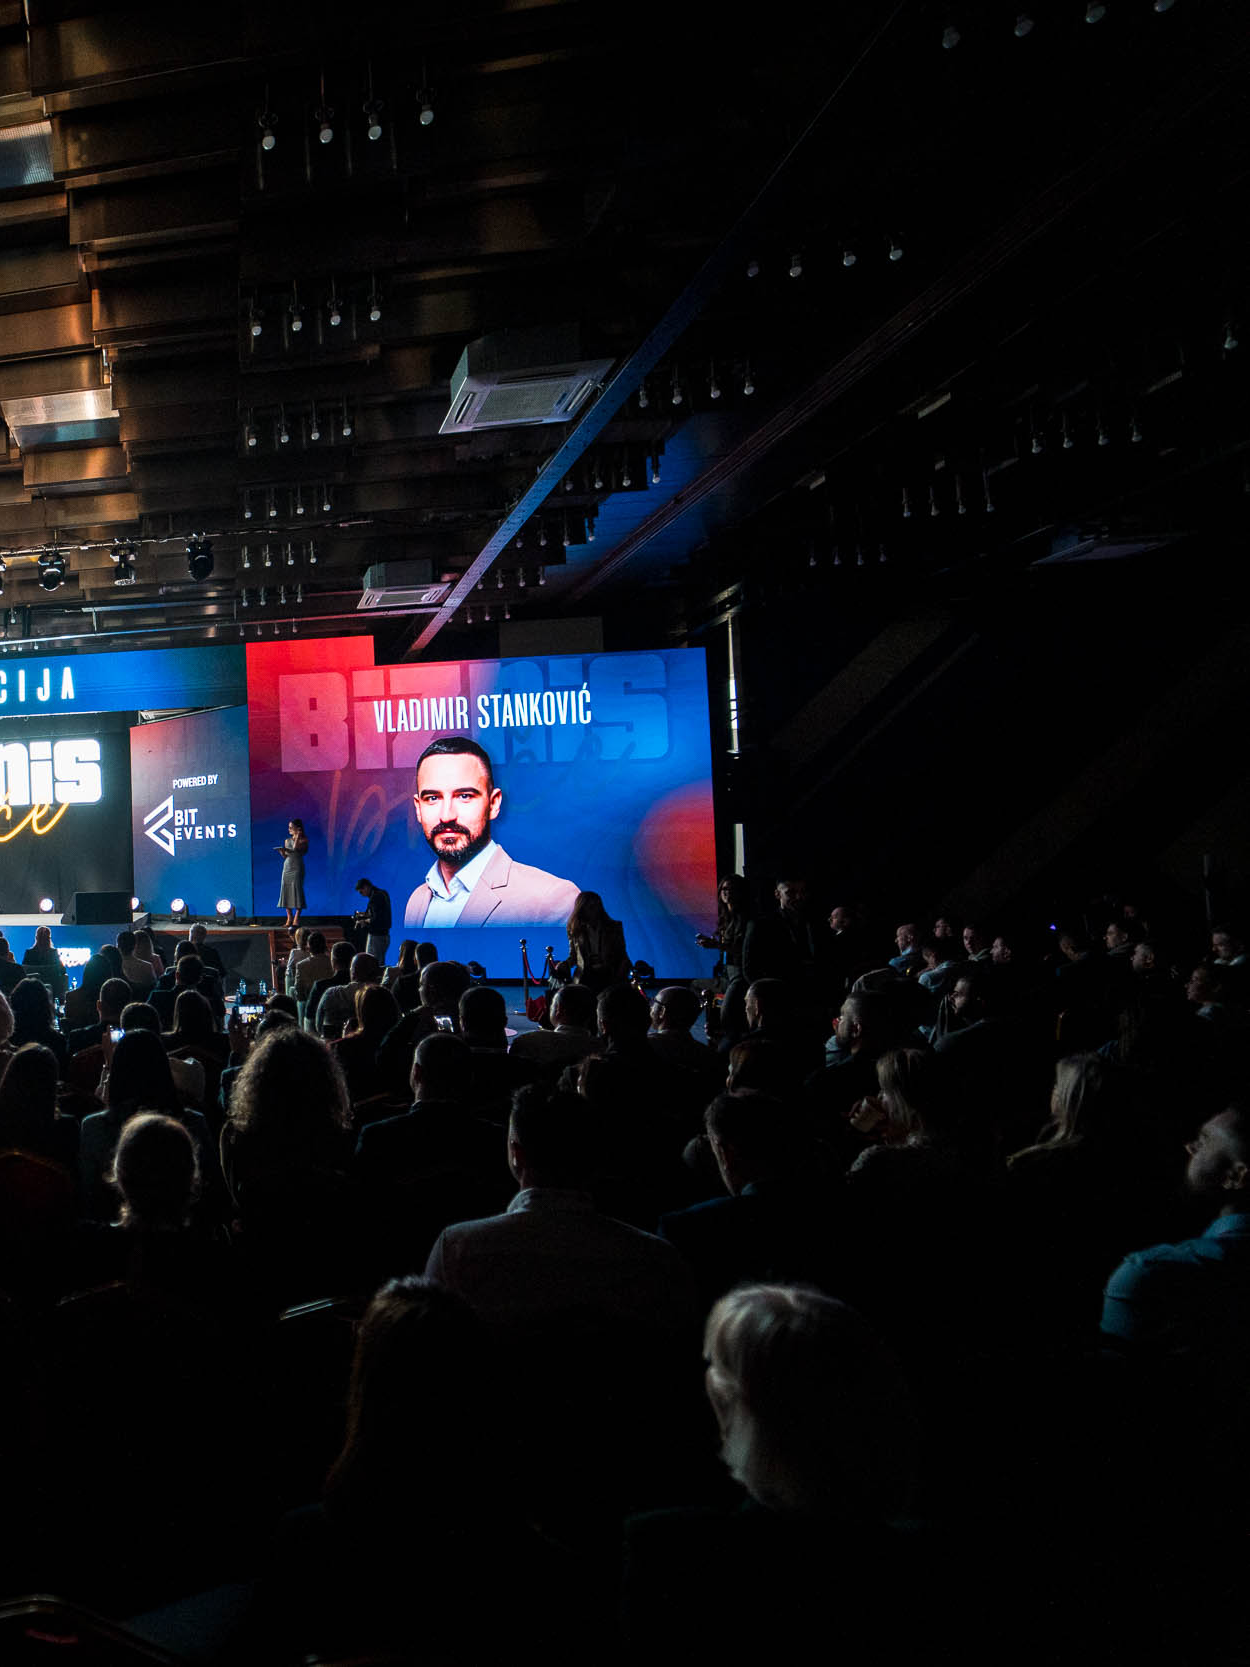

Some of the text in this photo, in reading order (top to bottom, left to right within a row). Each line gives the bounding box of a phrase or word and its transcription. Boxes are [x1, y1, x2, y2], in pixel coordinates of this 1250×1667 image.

[374, 682, 592, 733] VLADIMIR STANKOVIĆ
[173, 774, 218, 789] POWERED BY
[174, 808, 198, 826] BIT
[174, 824, 237, 840] EVENTS
